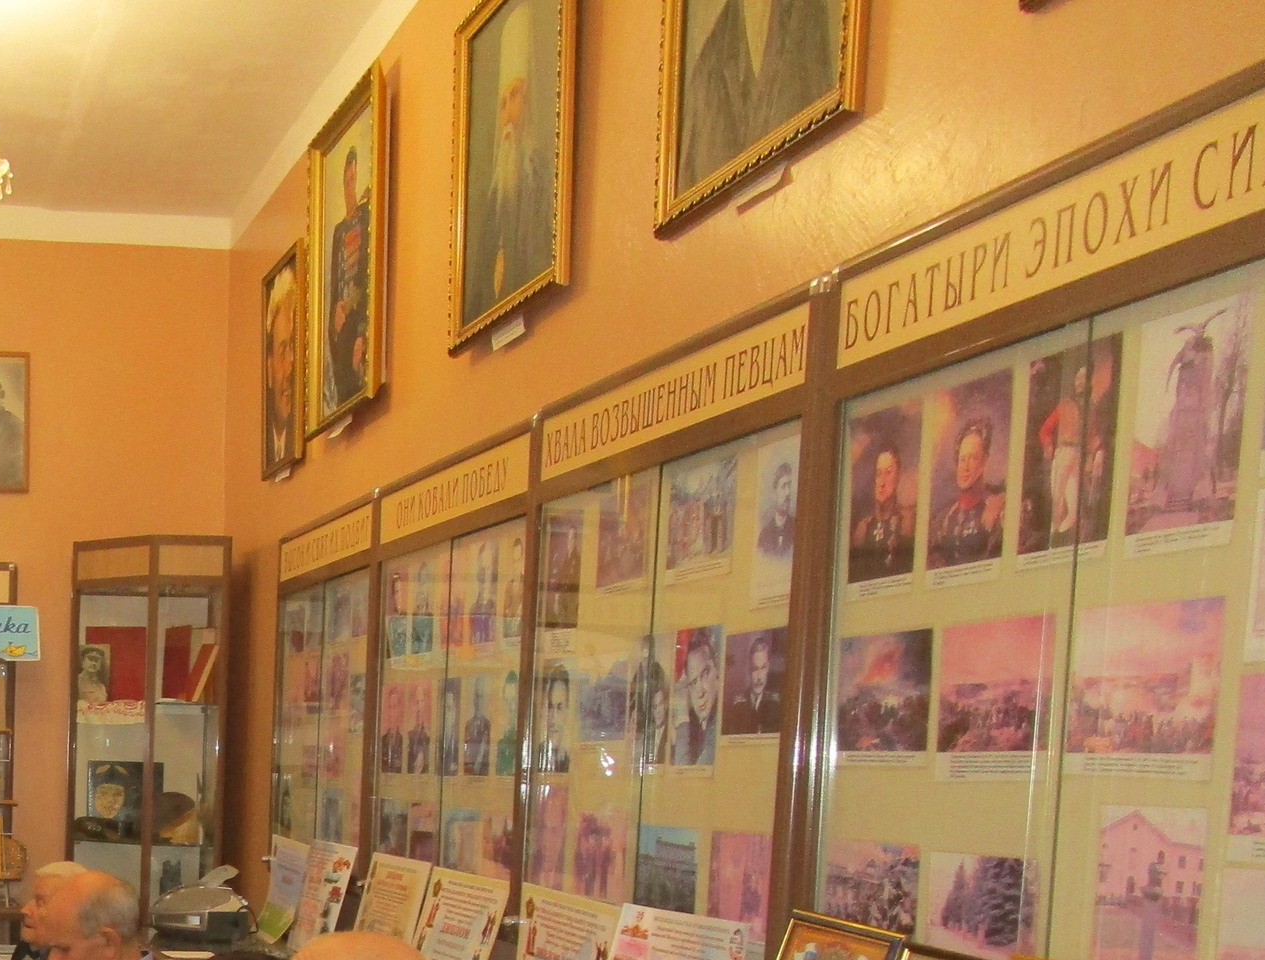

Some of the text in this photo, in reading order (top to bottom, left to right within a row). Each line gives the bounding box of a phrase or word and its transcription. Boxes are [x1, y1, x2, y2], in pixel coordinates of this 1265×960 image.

[844, 123, 1265, 350] БОГАТЫРИ ЭПОХИ СИ
[544, 324, 807, 468] ХВАЛА ВОЗВЫШЕННЫМ ПЕВЦАМ
[396, 456, 509, 529] ОНИ КОВАЛИ ПОБЕДУ
